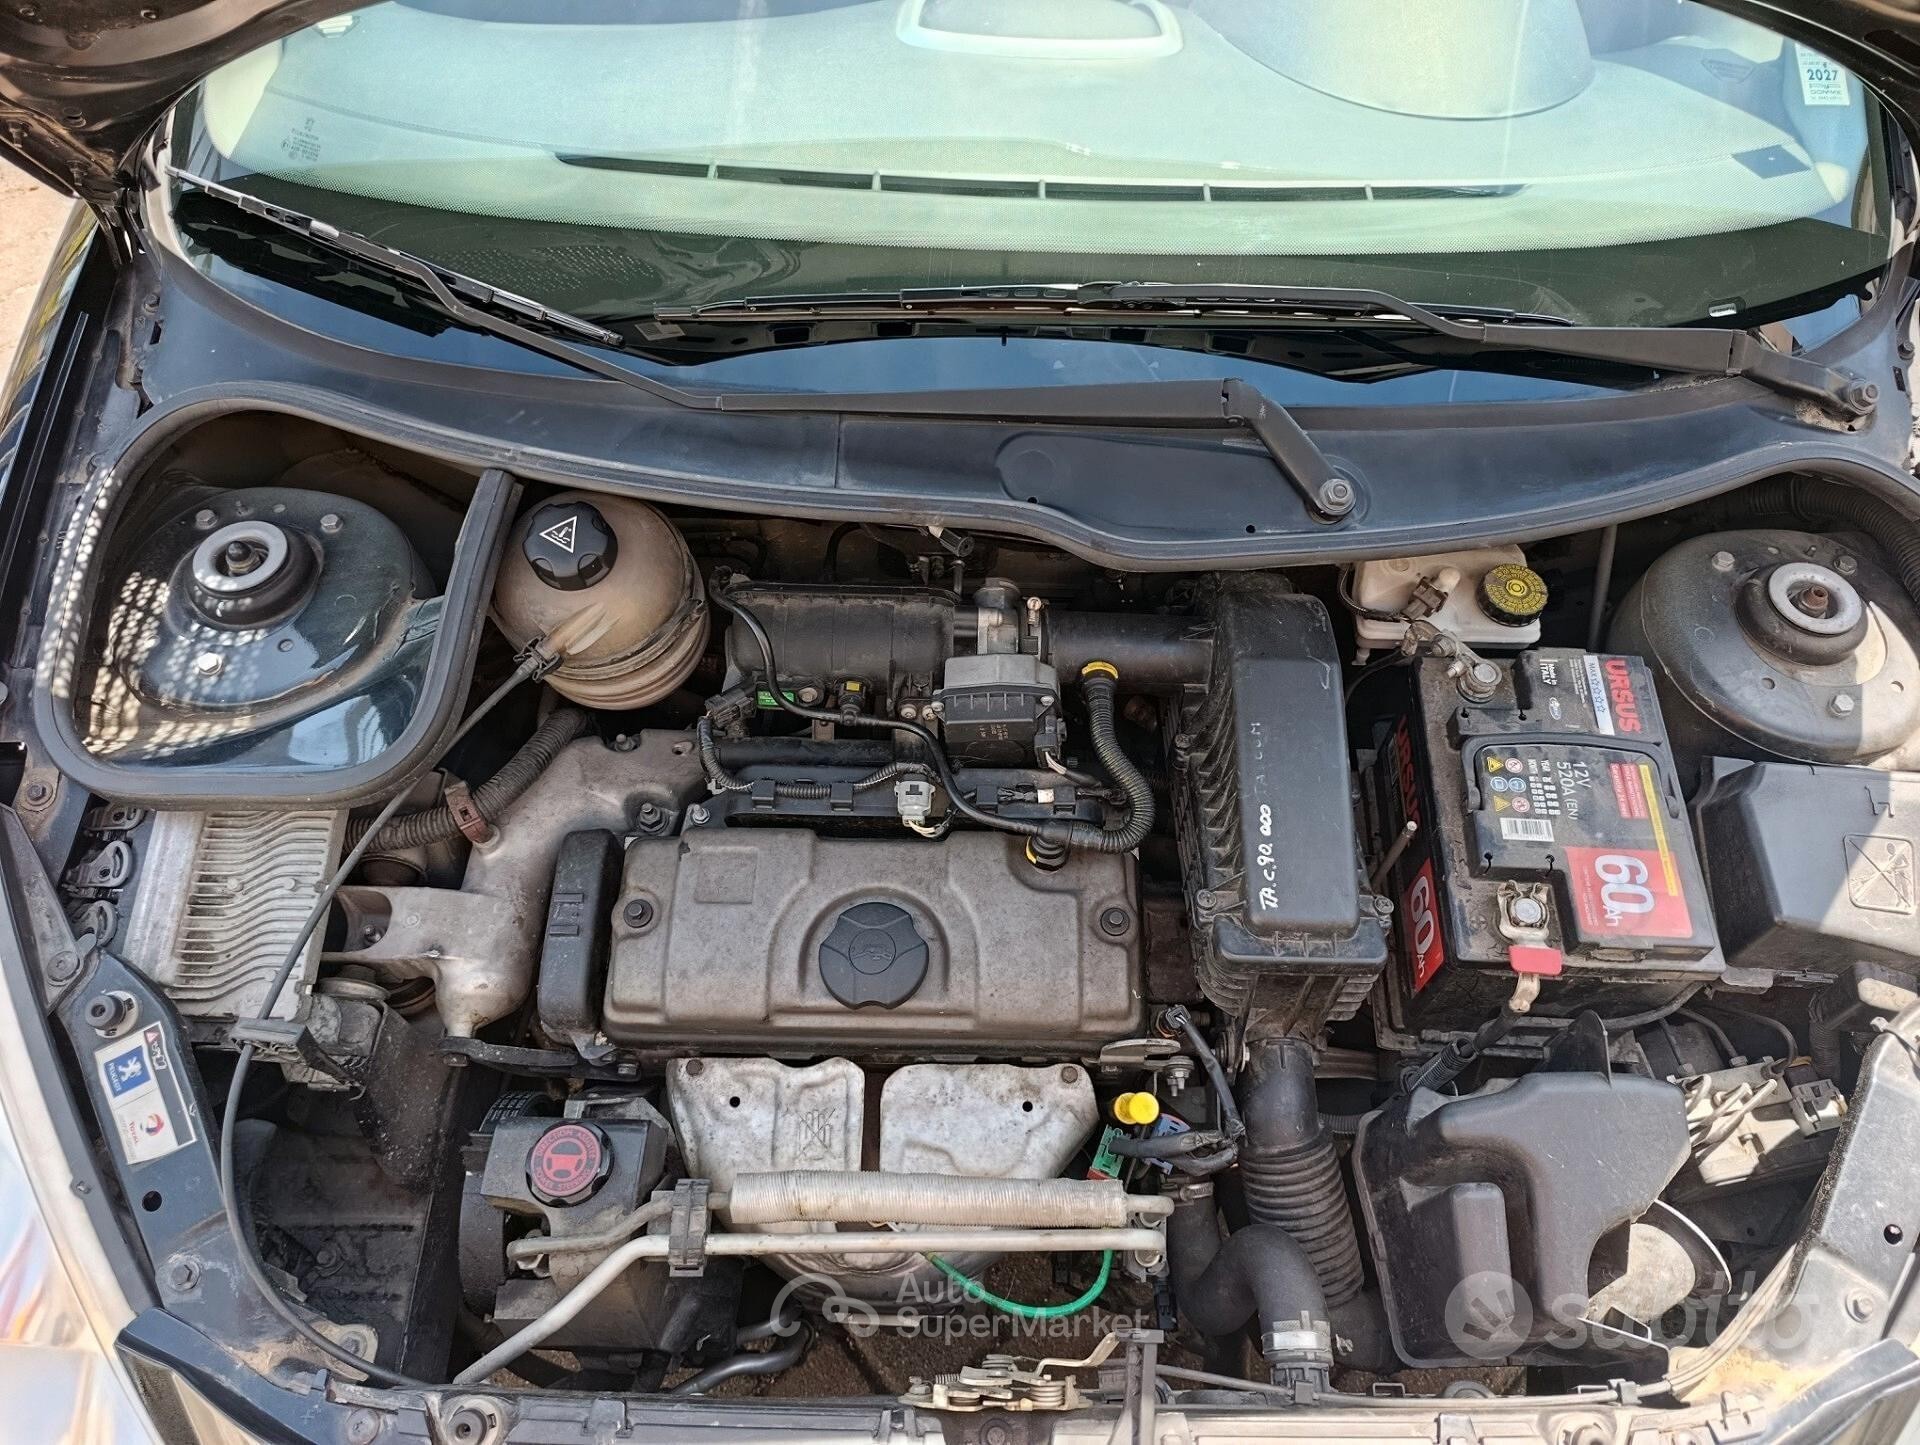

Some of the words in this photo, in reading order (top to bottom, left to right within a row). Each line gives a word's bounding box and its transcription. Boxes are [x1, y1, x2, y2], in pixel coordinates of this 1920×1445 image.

[1807, 69, 1838, 81] 2027
[1540, 663, 1552, 685] ITALY
[1605, 657, 1642, 733] URSUS
[1556, 761, 1577, 796] 520A
[1572, 761, 1592, 789] 12V
[1564, 798, 1579, 820] (EN)
[1594, 854, 1655, 927] 60Ah
[1410, 875, 1435, 978] 60Ah
[109, 1062, 122, 1092] PEUGEOT
